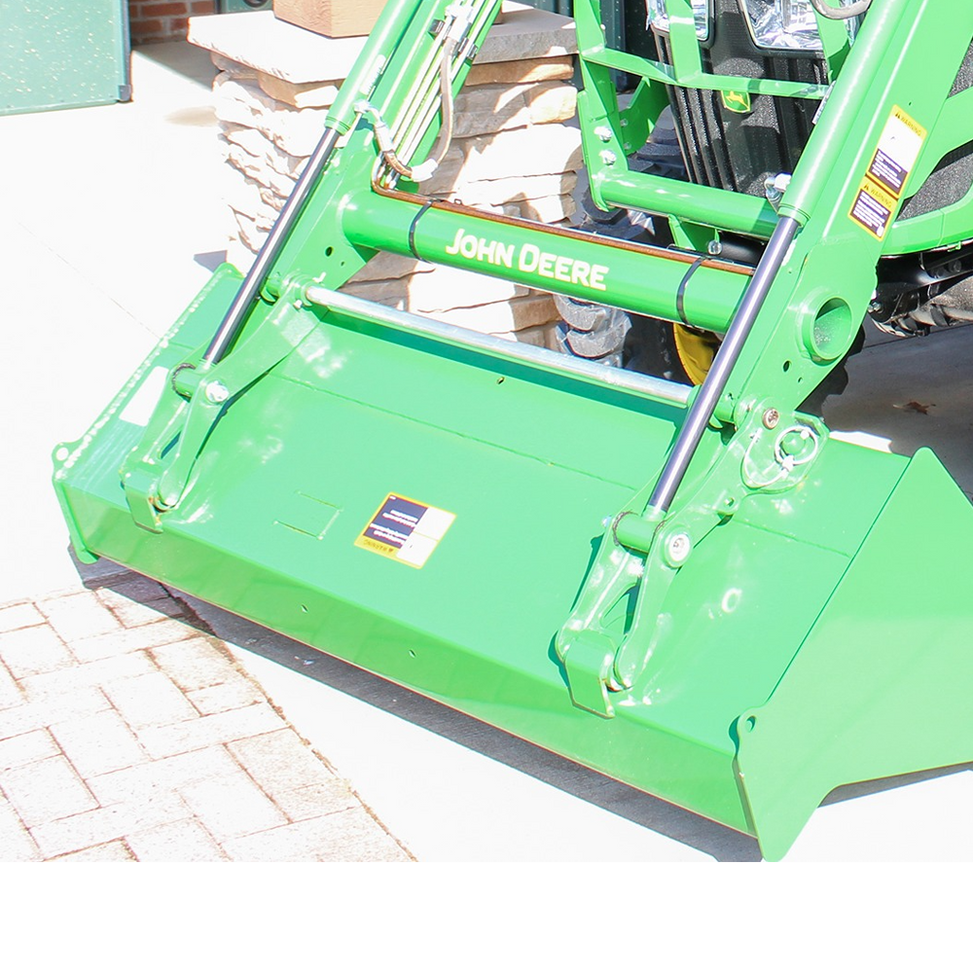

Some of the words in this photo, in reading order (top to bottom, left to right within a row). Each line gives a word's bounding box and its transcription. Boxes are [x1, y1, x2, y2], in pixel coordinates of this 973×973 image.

[900, 115, 922, 137] WARNING
[445, 228, 515, 268] JOHN
[518, 243, 609, 291] DEERE
